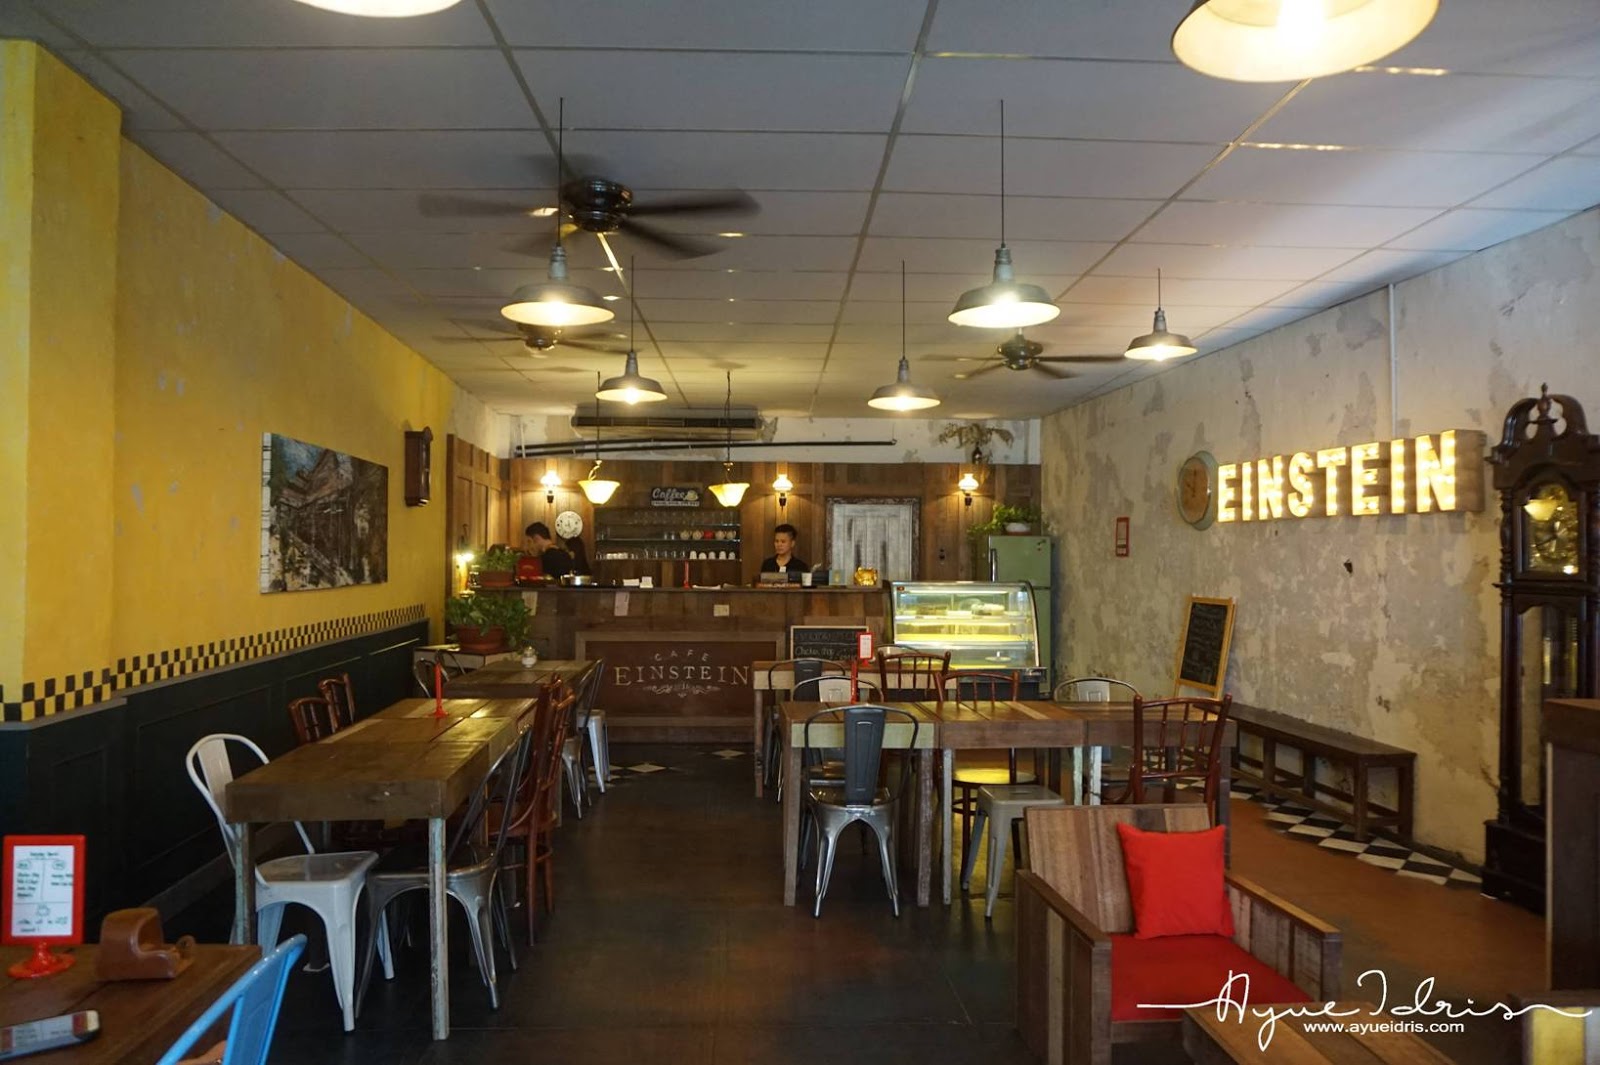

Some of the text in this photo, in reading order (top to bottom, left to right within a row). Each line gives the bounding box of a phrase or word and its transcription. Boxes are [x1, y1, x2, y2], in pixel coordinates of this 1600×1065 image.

[1218, 430, 1456, 522] EINSTEIN
[652, 487, 685, 502] Coffee
[654, 649, 709, 662] CAFE
[614, 665, 750, 686] EINSTEIN
